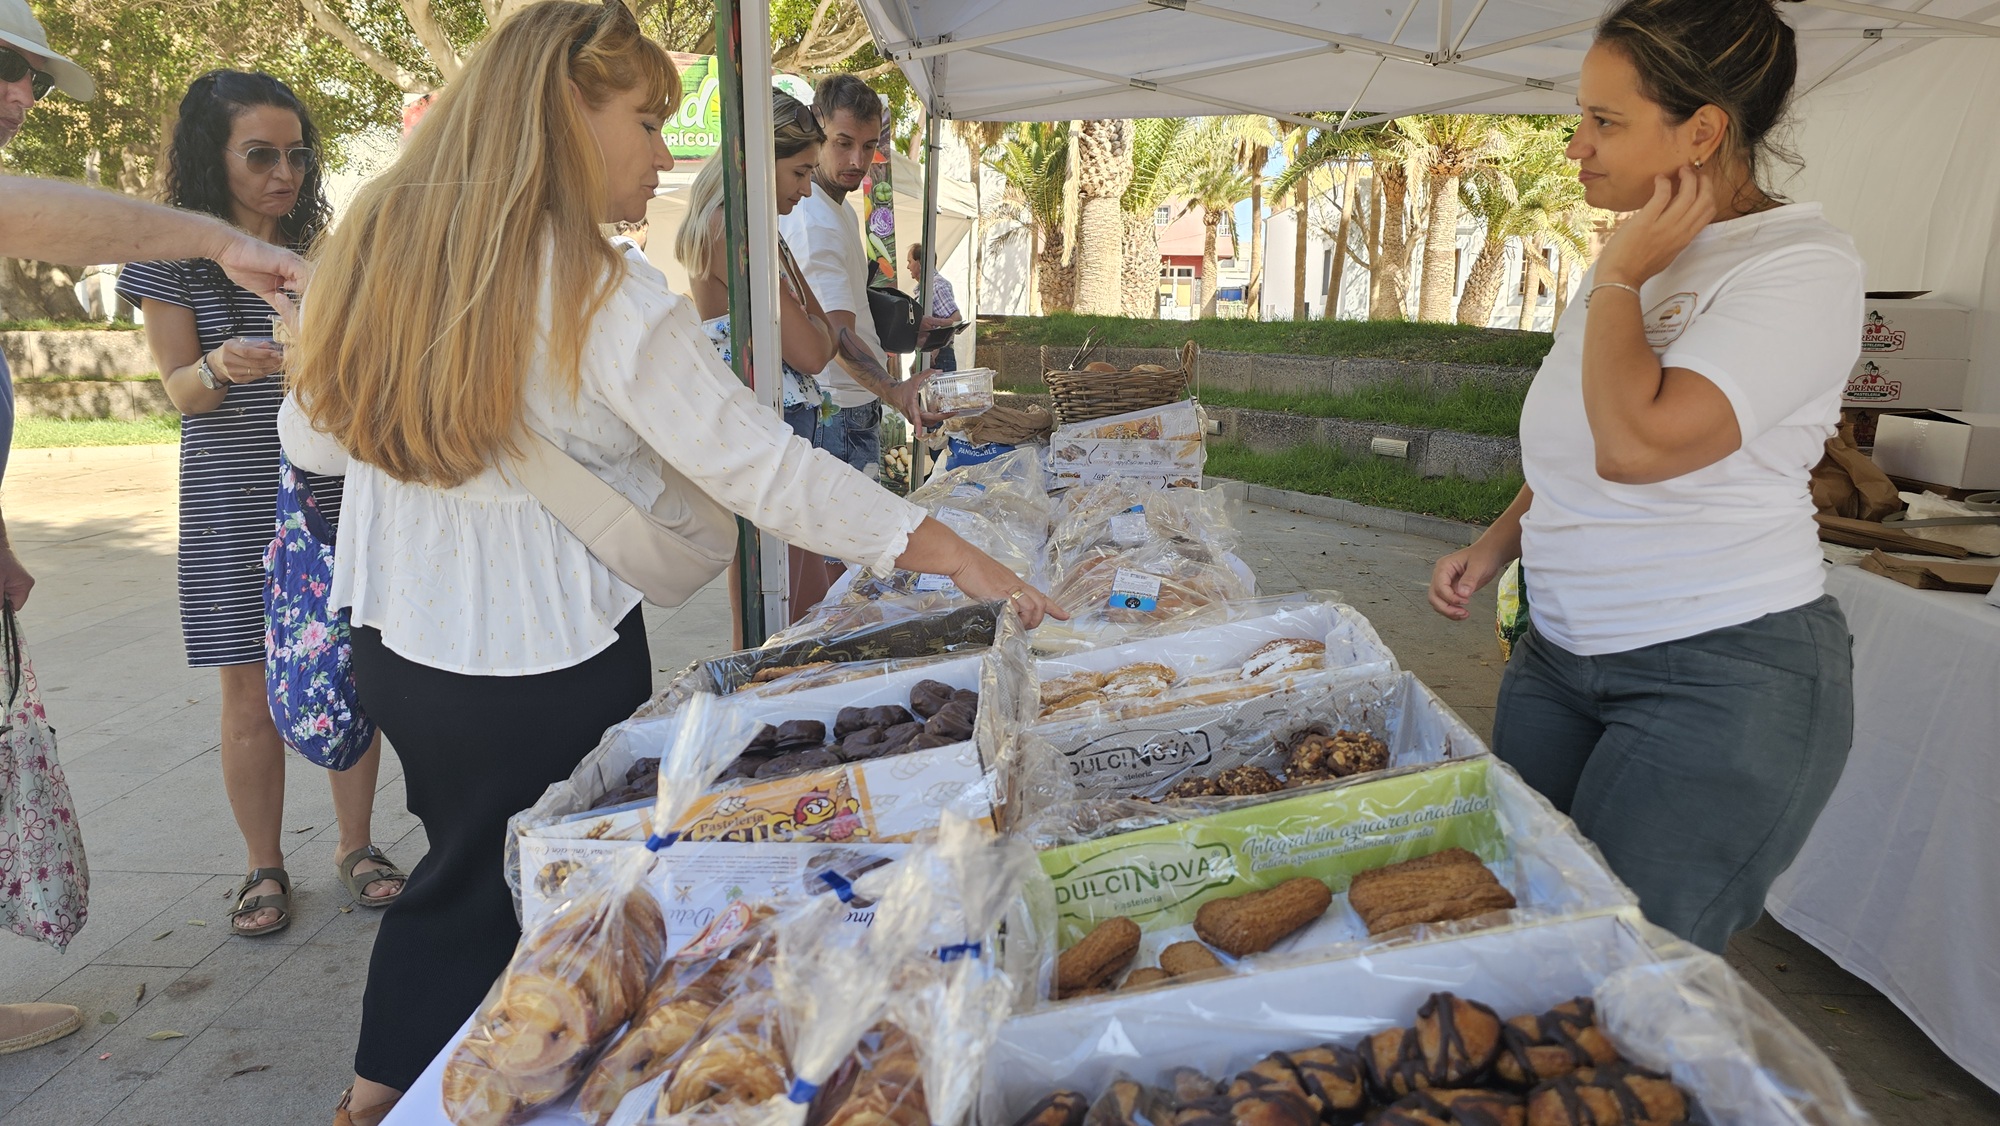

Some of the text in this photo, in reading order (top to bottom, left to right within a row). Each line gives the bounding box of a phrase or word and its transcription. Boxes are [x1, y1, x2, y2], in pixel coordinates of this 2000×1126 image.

[663, 130, 719, 147] RÍCOL
[1861, 334, 1903, 346] RENCRIS
[1844, 384, 1899, 396] ORENCRIS
[1241, 828, 1312, 859] Integral
[1313, 826, 1336, 844] sin
[1413, 795, 1490, 824] añadidos
[1055, 856, 1210, 905] DULCINOVA
